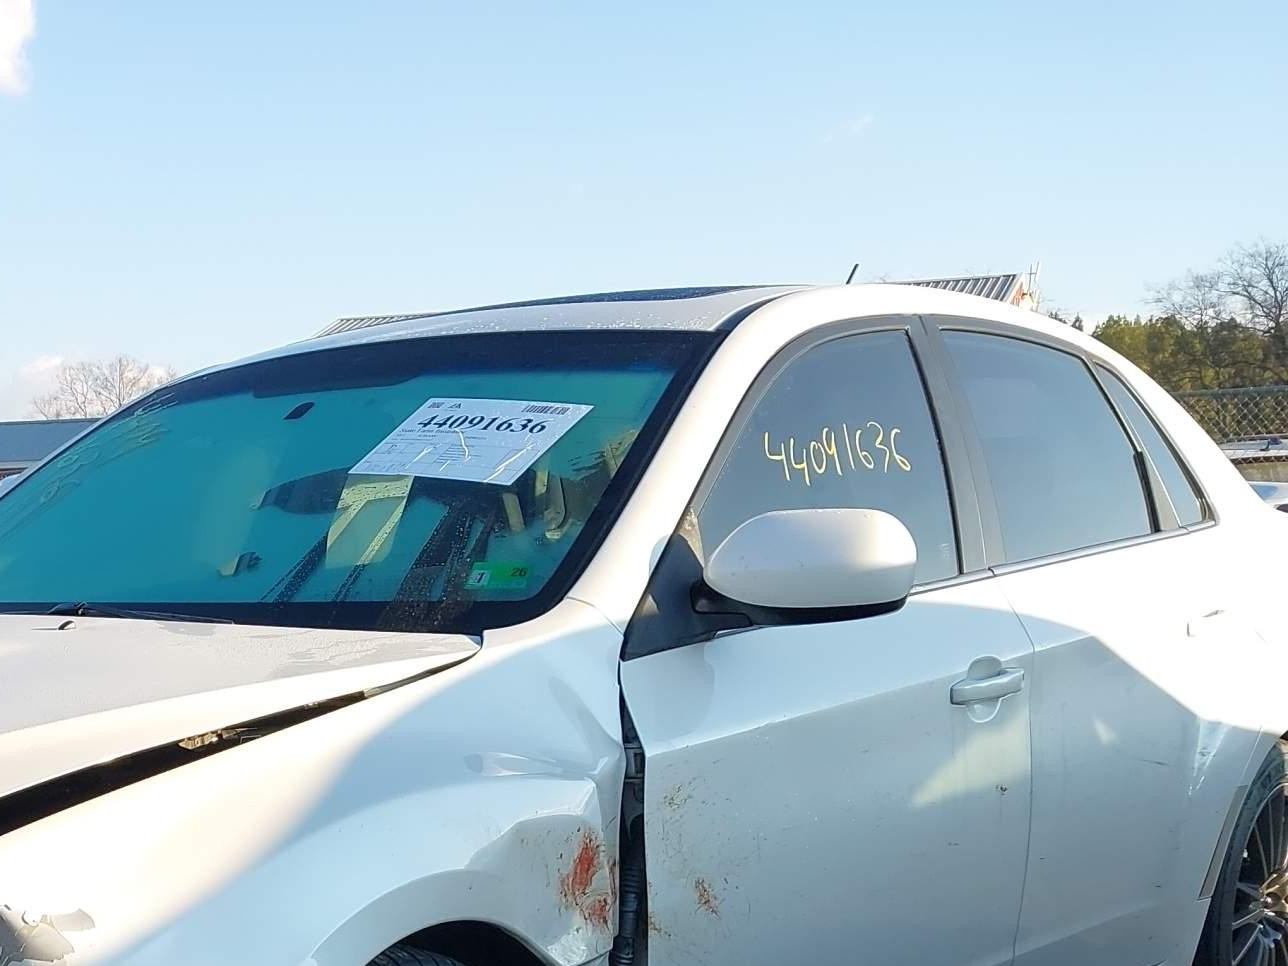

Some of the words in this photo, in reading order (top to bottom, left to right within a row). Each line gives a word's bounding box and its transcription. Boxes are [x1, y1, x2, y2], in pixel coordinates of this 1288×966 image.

[418, 414, 554, 434] 44091636
[764, 420, 912, 487] 44091636
[511, 567, 528, 577] 26
